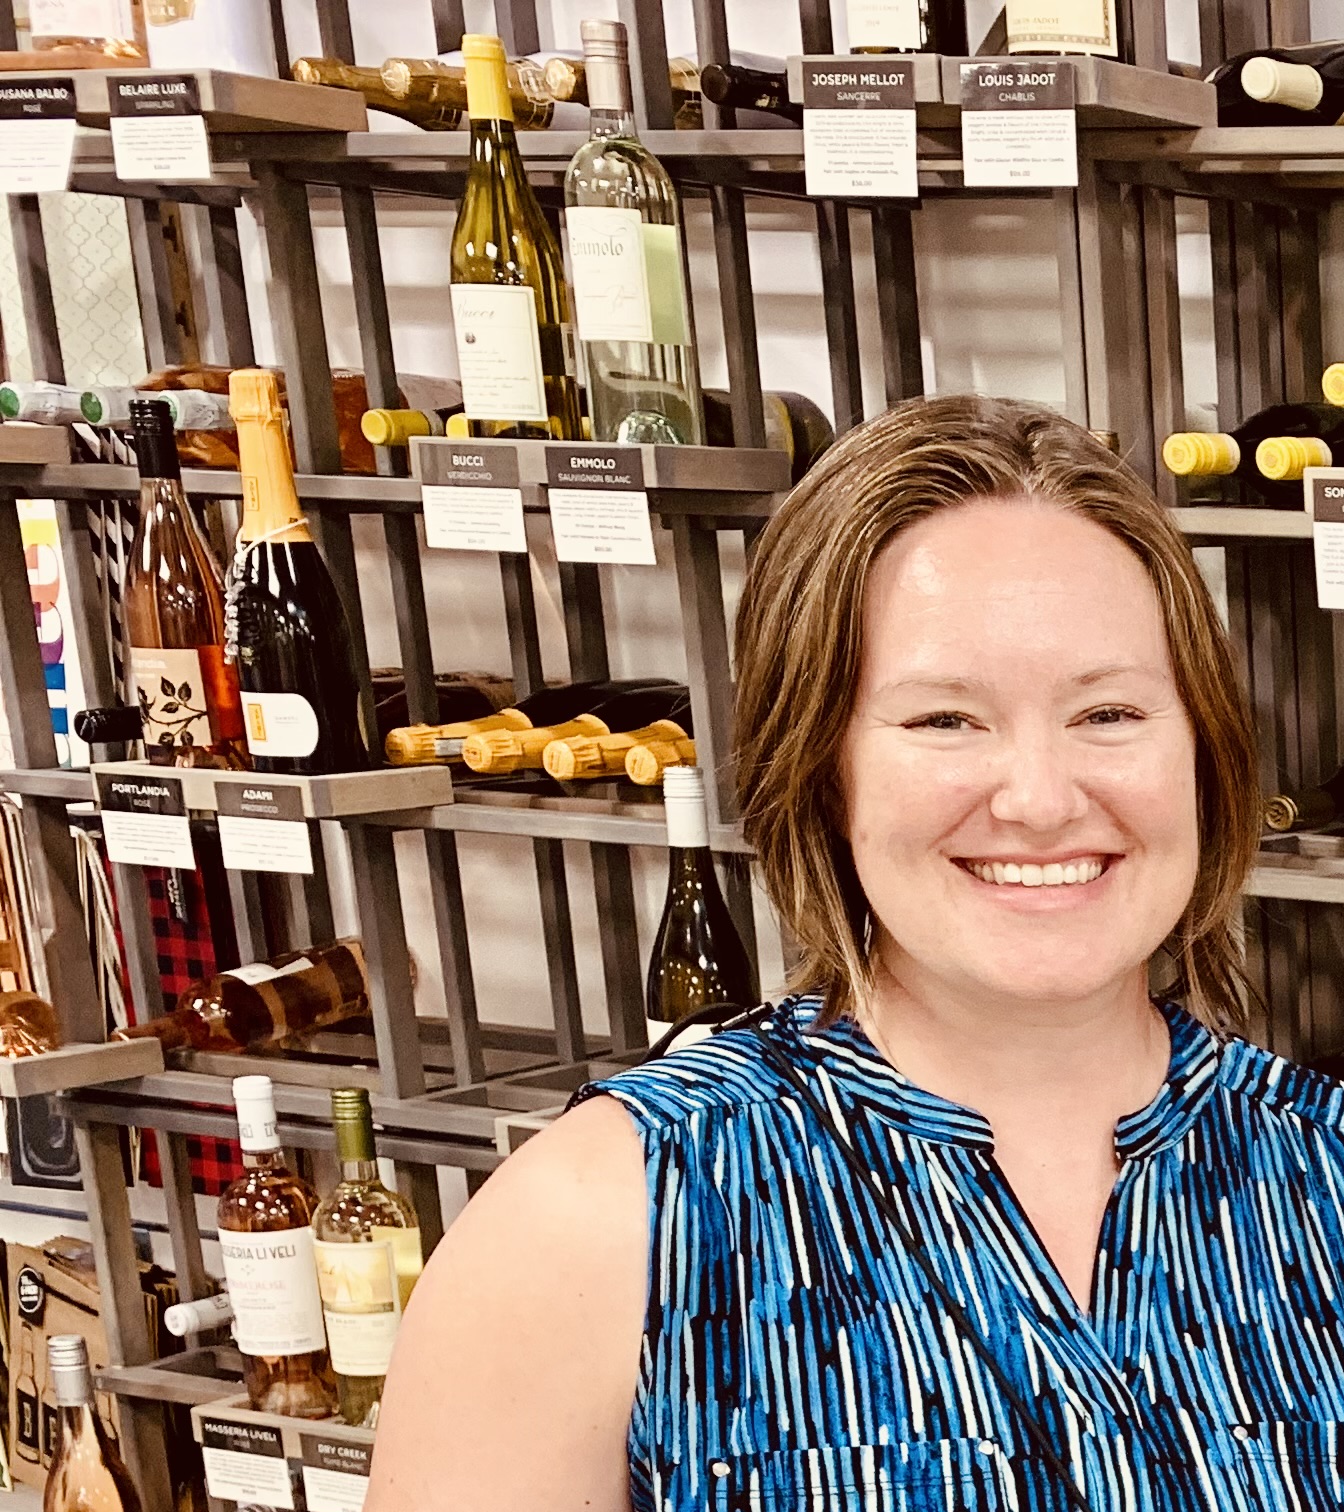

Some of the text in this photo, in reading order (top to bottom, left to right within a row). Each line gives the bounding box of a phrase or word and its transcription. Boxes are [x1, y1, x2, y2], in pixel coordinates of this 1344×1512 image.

[812, 73, 904, 86] JOSEPH MELLOT
[979, 73, 1055, 87] LOUIS JADOT
[36, 87, 68, 99] BALBO
[119, 83, 186, 96] BELAIRE LUXE
[837, 92, 881, 101] SANCERRE
[999, 92, 1035, 102] CHABLIS
[452, 455, 483, 467] BUCCI
[570, 456, 616, 469] EMMOLO
[558, 473, 631, 485] SAUVIGNON BLANC
[112, 783, 170, 797] PORTLANDIA
[242, 790, 273, 801] ADAMI
[205, 1423, 248, 1438] MASSERIA
[317, 1444, 367, 1459] DRY CREEK
